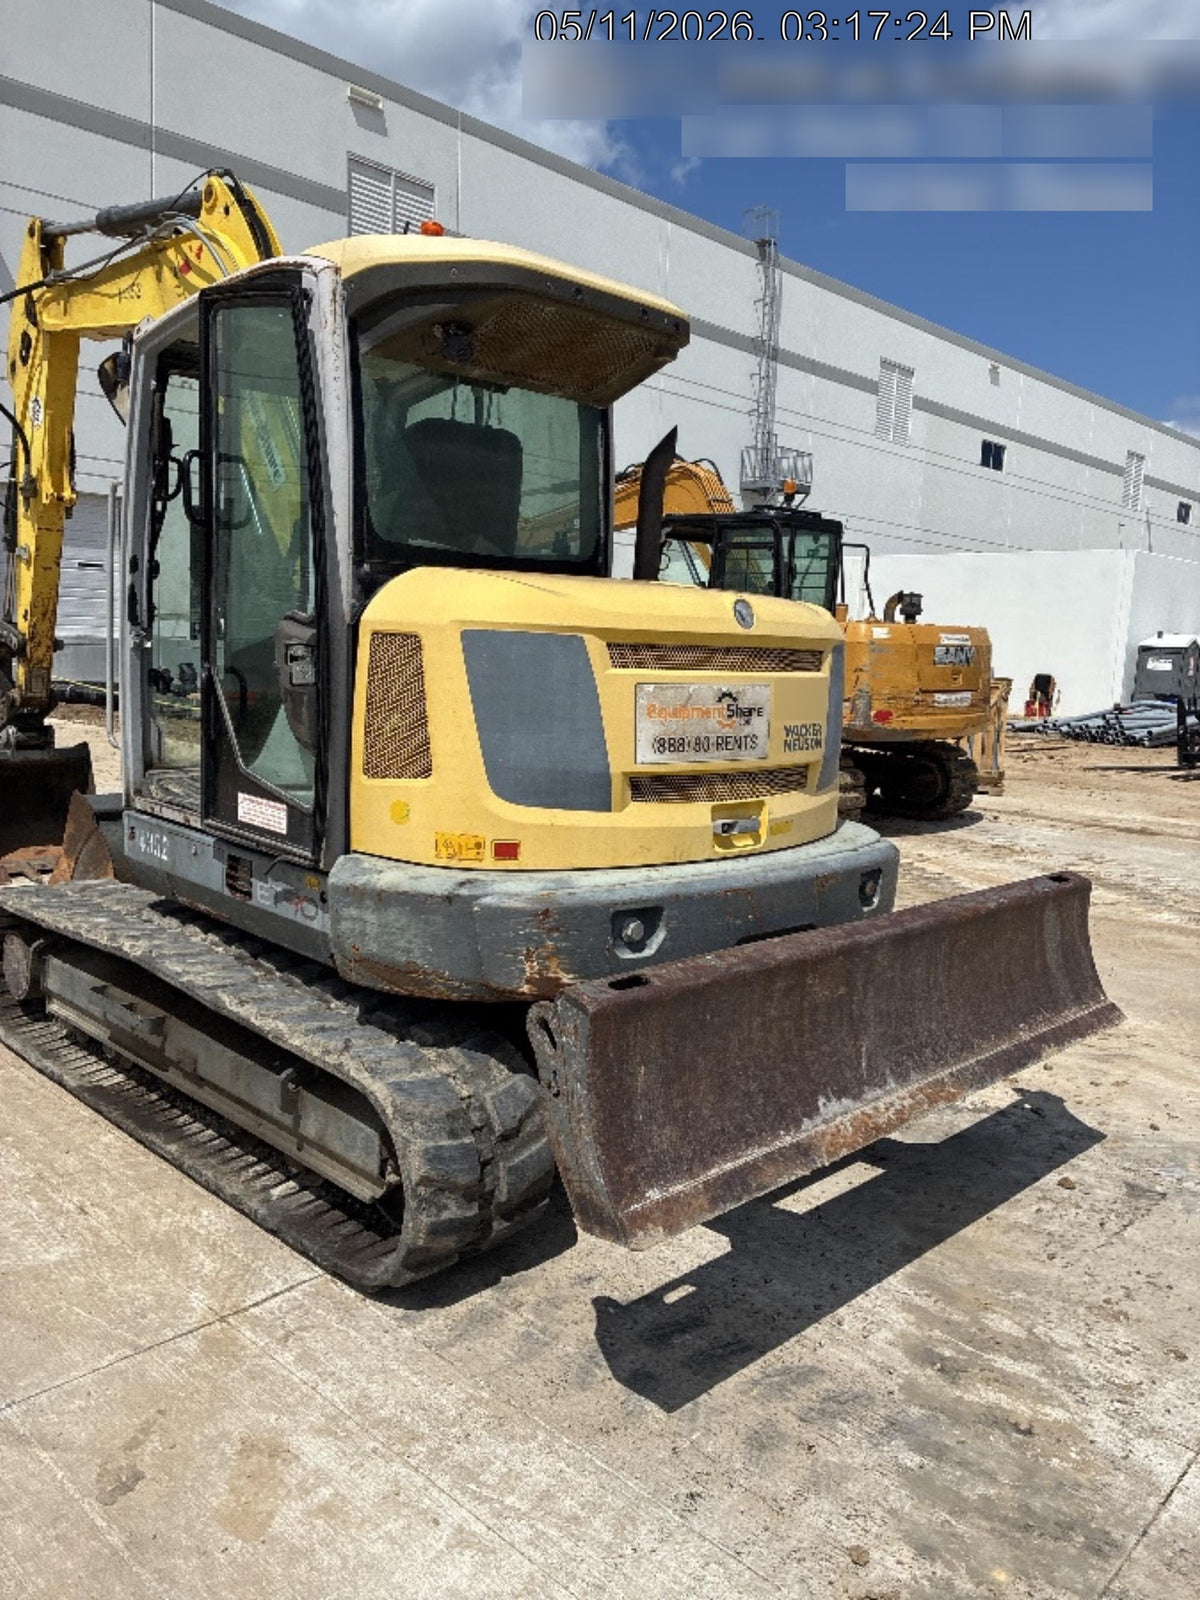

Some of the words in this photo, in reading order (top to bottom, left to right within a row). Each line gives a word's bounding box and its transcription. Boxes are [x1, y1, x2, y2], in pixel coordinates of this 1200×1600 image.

[646, 703, 764, 721] EquipmentShare
[783, 723, 822, 738] WACKER
[783, 737, 822, 753] NEUSON
